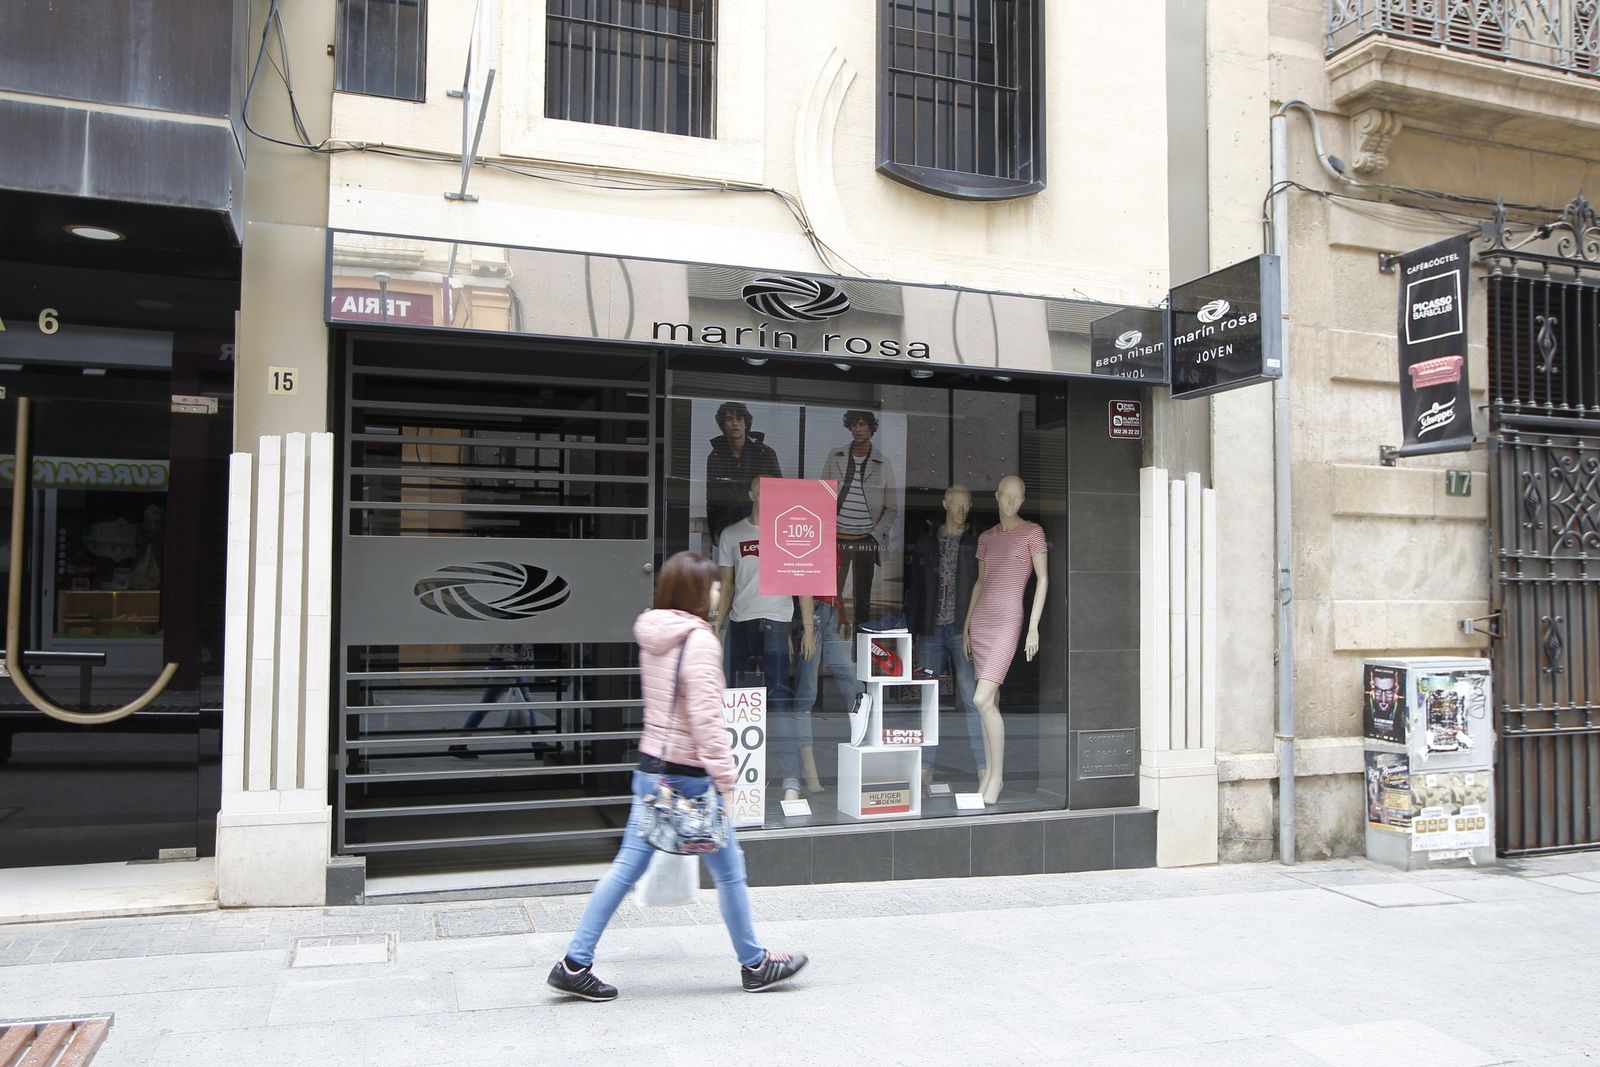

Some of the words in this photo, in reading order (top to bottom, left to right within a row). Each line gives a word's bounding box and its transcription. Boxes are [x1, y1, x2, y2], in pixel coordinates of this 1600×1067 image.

[1412, 295, 1453, 312] PICASSO
[1412, 304, 1453, 320] BAR&CLUB
[38, 307, 60, 335] 6
[1174, 324, 1215, 346] marín
[1221, 312, 1258, 332] rosa
[651, 321, 798, 351] marín
[823, 334, 931, 361] rosa
[1196, 344, 1234, 364] JOVEN
[273, 371, 293, 391] 15
[1420, 407, 1455, 429] Schweppes
[1449, 471, 1471, 494] 17
[783, 524, 815, 538] -10%
[869, 792, 901, 800] HILFIGER
